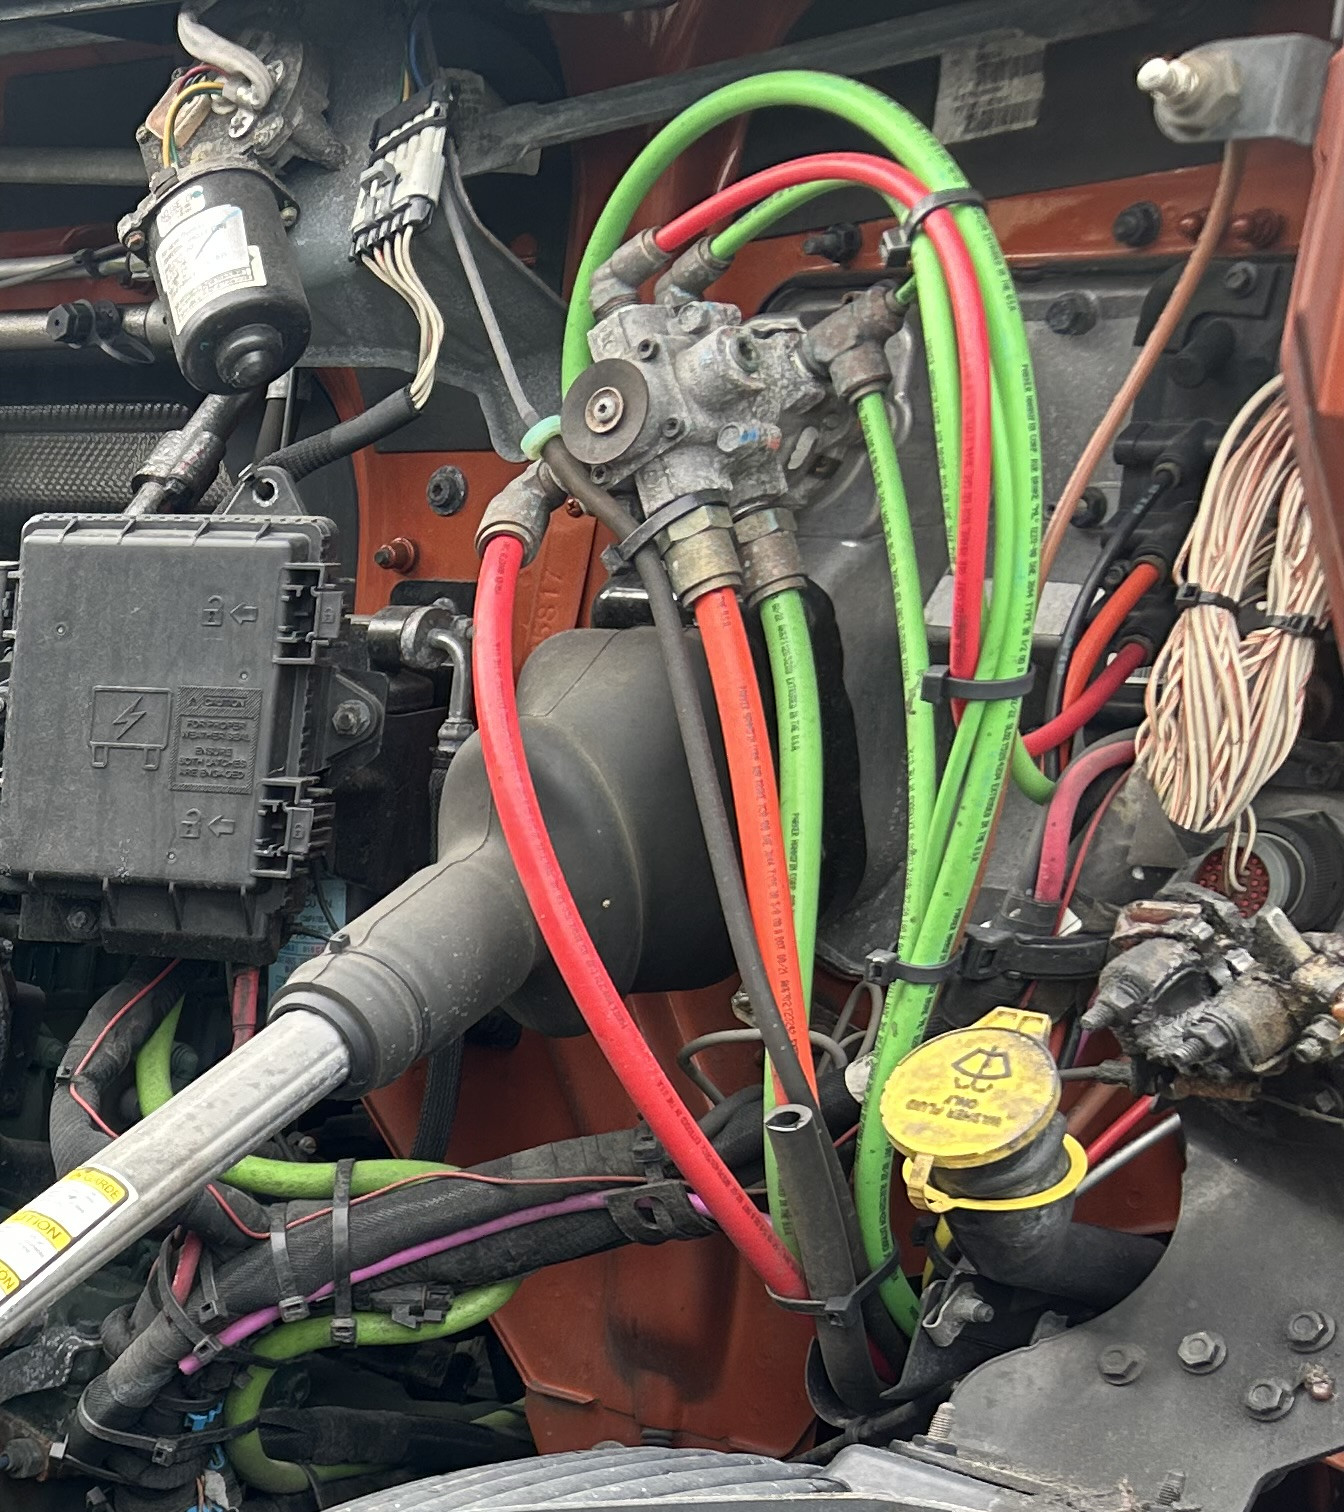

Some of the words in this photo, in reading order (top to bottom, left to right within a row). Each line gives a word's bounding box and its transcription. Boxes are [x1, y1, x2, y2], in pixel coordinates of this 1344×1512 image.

[1023, 602, 1033, 624] TYPE
[786, 677, 799, 709] EXTRUDED
[182, 731, 225, 740] WEATHER
[208, 722, 247, 731] PROPER
[195, 746, 232, 757] ENSURE
[200, 769, 245, 780] ENGAGED
[983, 783, 1000, 818] EXTRUDED
[791, 812, 800, 837] PARKER
[905, 1099, 944, 1116] FLUID
[943, 1095, 978, 1110] ONLY
[946, 1109, 1002, 1128] WASHER
[14, 1212, 62, 1240] UTION
